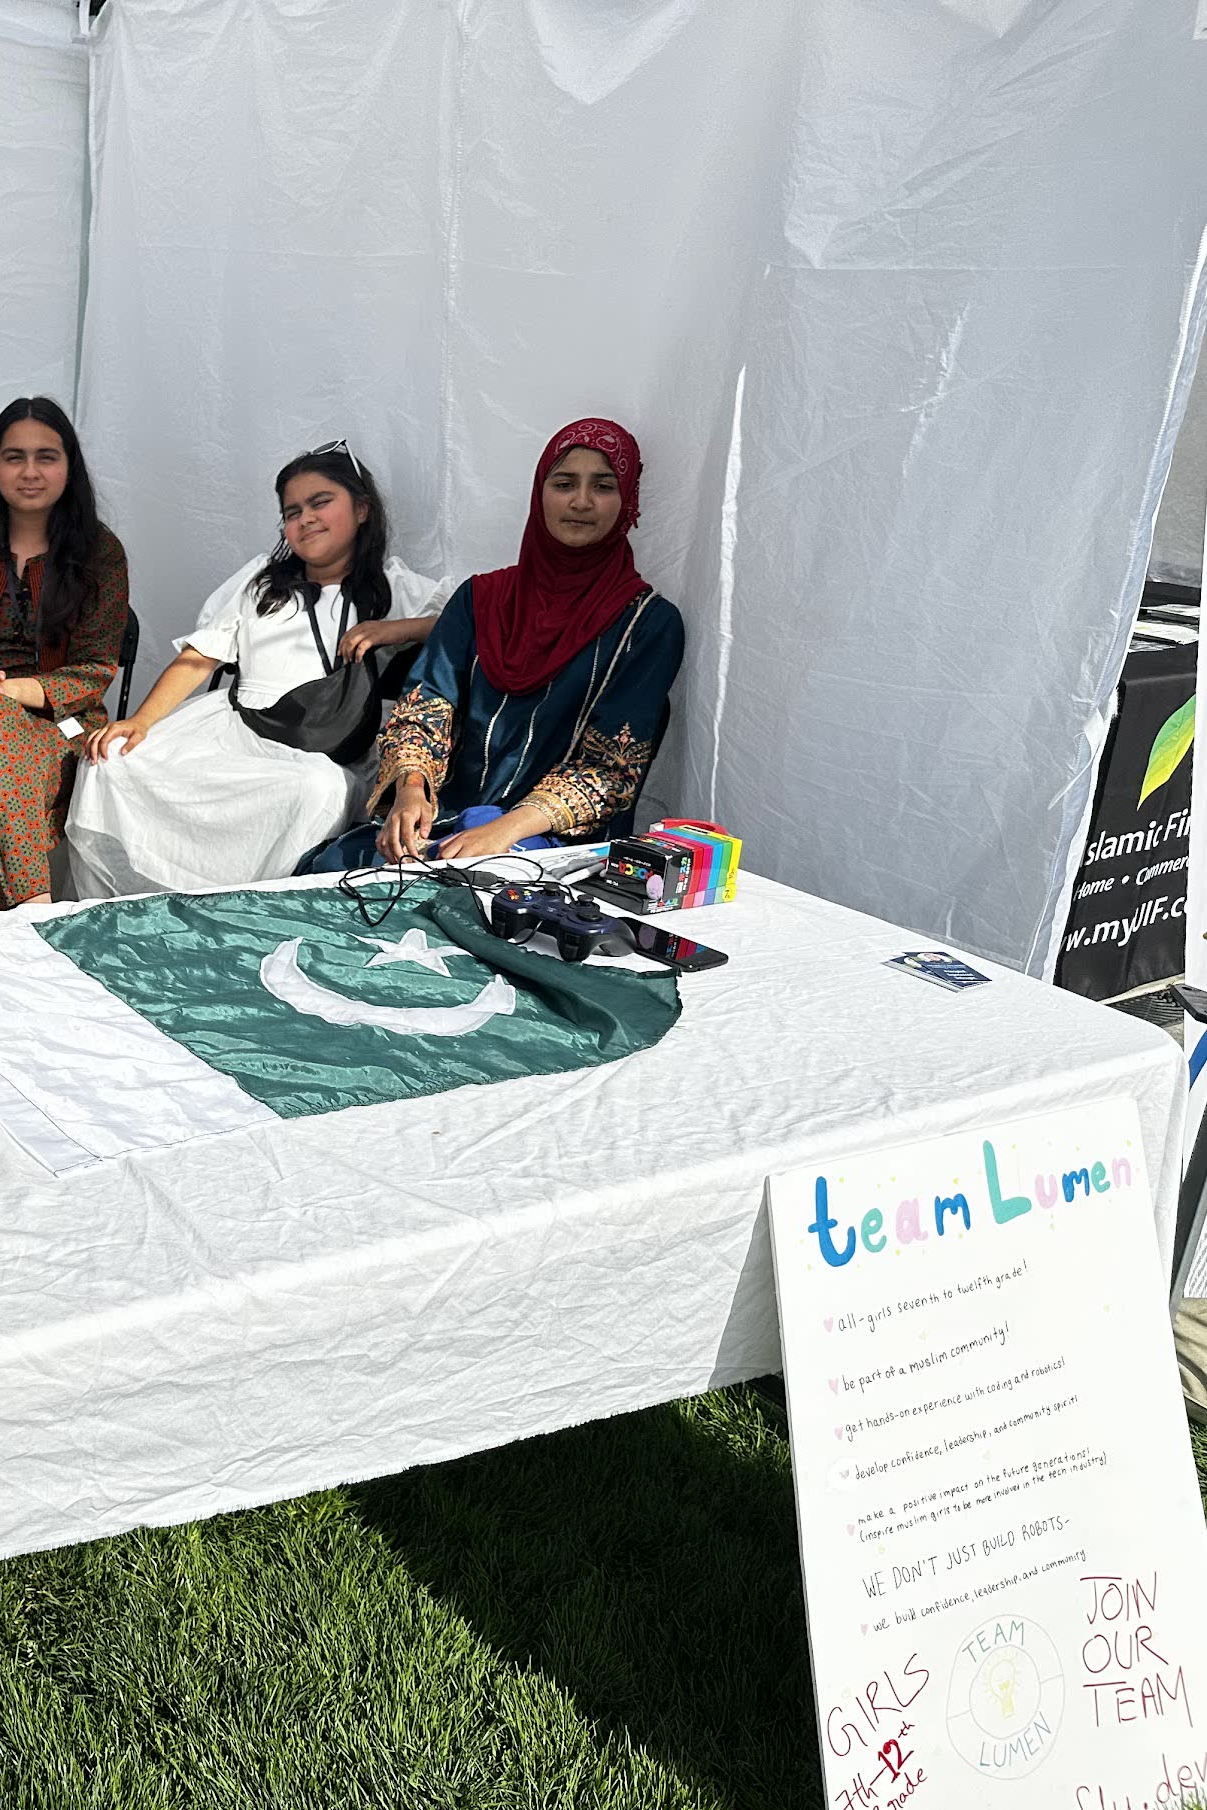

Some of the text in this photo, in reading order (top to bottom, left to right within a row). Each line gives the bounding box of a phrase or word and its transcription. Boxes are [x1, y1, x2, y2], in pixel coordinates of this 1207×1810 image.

[1082, 821, 1163, 867] slamic
[1073, 877, 1115, 902] Home
[808, 1140, 1132, 1267] team Lumen
[838, 1258, 1027, 1332] all-girls seventh to twelfth grade!
[842, 1321, 1009, 1394] be part of a muslim community!
[845, 1356, 1065, 1442] get hands-on experience with coding and robotics!
[855, 1462, 889, 1480] develop
[891, 1445, 943, 1468] confidence,
[943, 1429, 992, 1452] leadership,
[993, 1422, 1007, 1434] and
[1009, 1405, 1051, 1428] community
[858, 1509, 885, 1526] make
[889, 1507, 896, 1515] a
[903, 1493, 937, 1512] positive
[939, 1482, 969, 1500] impact
[974, 1479, 985, 1488] on
[987, 1473, 1001, 1484] the
[1003, 1464, 1029, 1479] future
[859, 1526, 894, 1543] (inspire
[897, 1514, 928, 1532] muslim
[930, 1506, 951, 1522] girls
[953, 1504, 961, 1512] to
[963, 1501, 973, 1510] be
[975, 1494, 993, 1506] more
[993, 1483, 1021, 1499] involved
[1023, 1481, 1030, 1489] in
[1032, 1474, 1045, 1485] the
[1048, 1468, 1067, 1480] tech
[862, 1515, 1071, 1598] WE DON'T JUST BUILD ROBOTS-
[873, 1618, 890, 1632] we
[894, 1607, 917, 1625] build
[921, 1592, 975, 1617] confidence,
[1023, 1566, 1039, 1580] and
[1041, 1549, 1086, 1572] community
[1079, 1571, 1157, 1625] JOIN
[962, 1620, 1025, 1663] TEAM
[1083, 1625, 1169, 1674] OUR
[827, 1652, 930, 1757] GIRLS
[1083, 1665, 1193, 1728] TEAM
[979, 1711, 1051, 1768] LUMEN
[872, 1768, 928, 1810] rade
